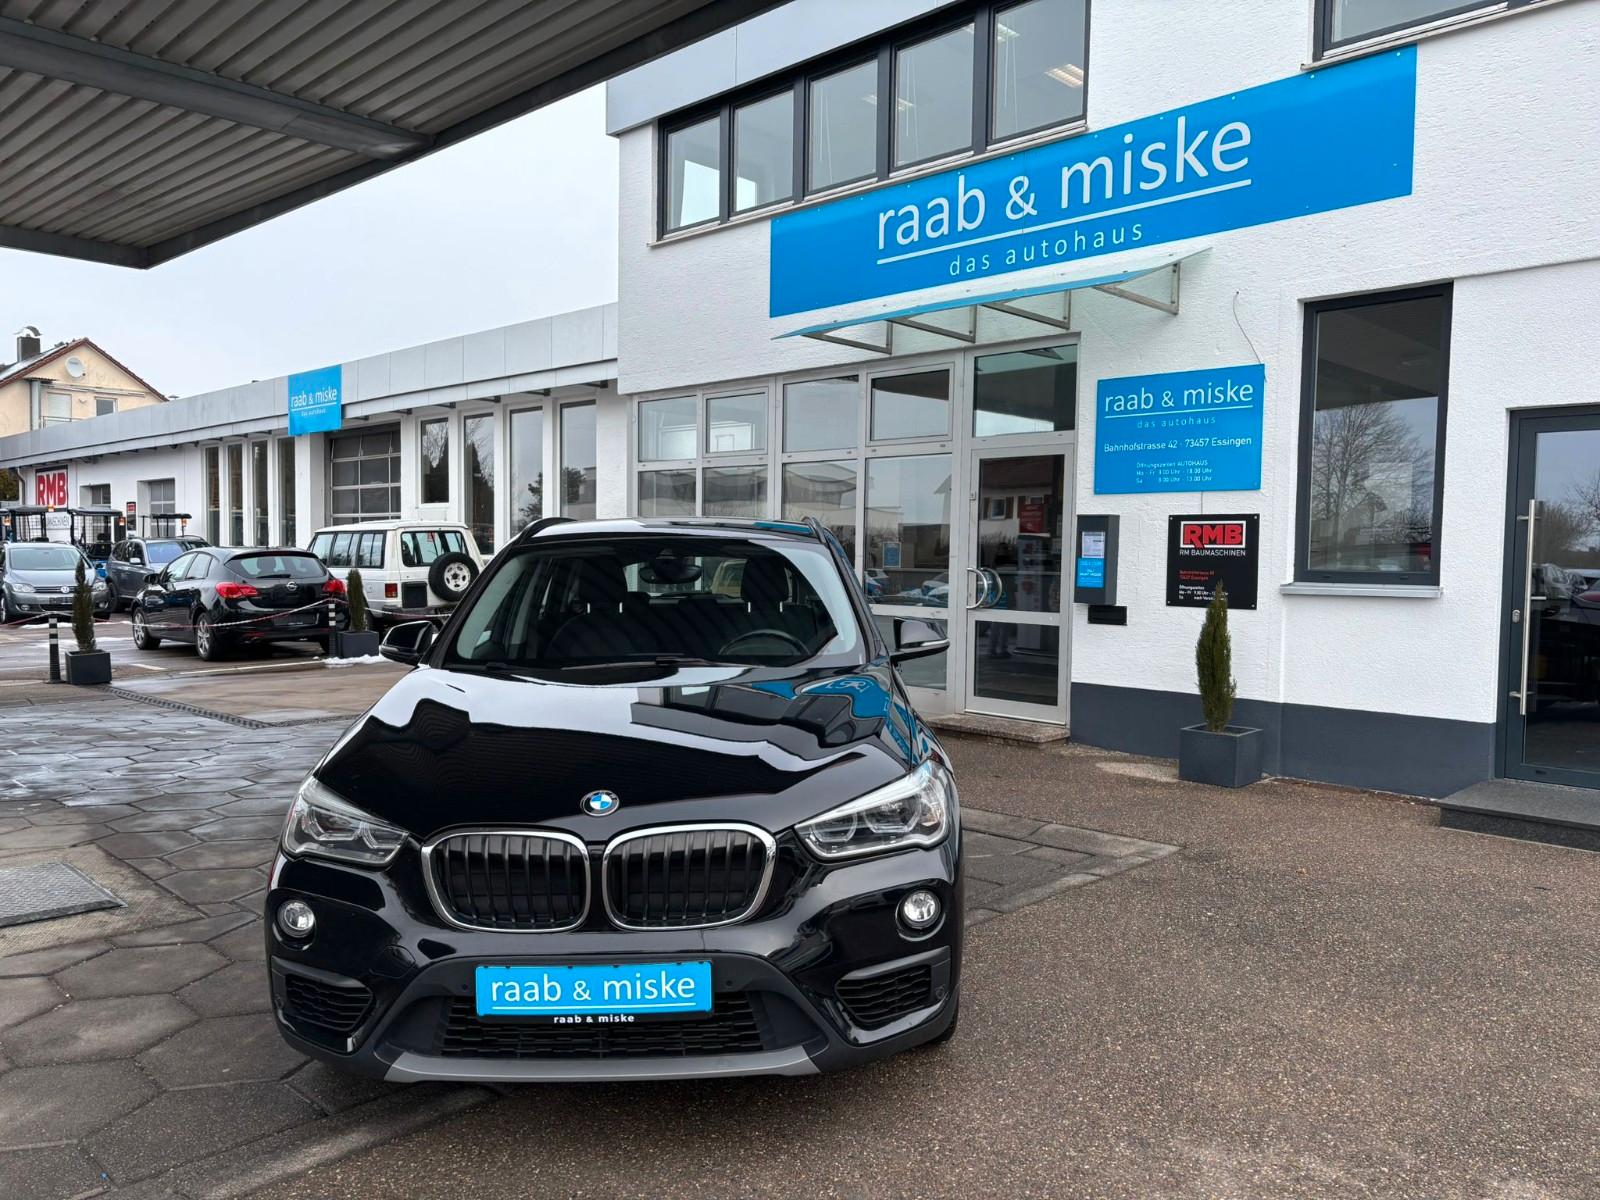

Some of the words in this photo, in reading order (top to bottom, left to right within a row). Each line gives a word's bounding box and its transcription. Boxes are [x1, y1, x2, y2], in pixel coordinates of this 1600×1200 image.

[877, 175, 986, 250] raab
[1004, 176, 1038, 221] &
[1060, 115, 1252, 209] miske
[948, 253, 991, 276] das
[1006, 222, 1143, 266] autohaus
[290, 389, 307, 408] raab
[308, 392, 314, 405] &
[315, 385, 338, 403] miske
[1104, 386, 1154, 412] raab
[1161, 390, 1175, 407] &
[1183, 379, 1254, 406] miske
[1137, 419, 1156, 429] das
[1161, 415, 1216, 428] autohaus
[1104, 441, 1166, 452] Bahnhofstrasse
[1168, 439, 1178, 449] 42
[1185, 437, 1210, 448] 73457
[1211, 435, 1252, 448] Essingen
[1177, 459, 1209, 467] AUTOHAUS
[36, 472, 68, 506] RMB
[1202, 474, 1212, 482] Uhr
[1182, 524, 1243, 549] RMB
[1191, 549, 1246, 557] BAUMASCHINEN
[491, 973, 562, 1002] raab
[573, 980, 591, 1001] &
[603, 970, 696, 1000] miske
[553, 1014, 582, 1024] raab
[586, 1015, 594, 1023] &
[598, 1013, 635, 1023] miske
